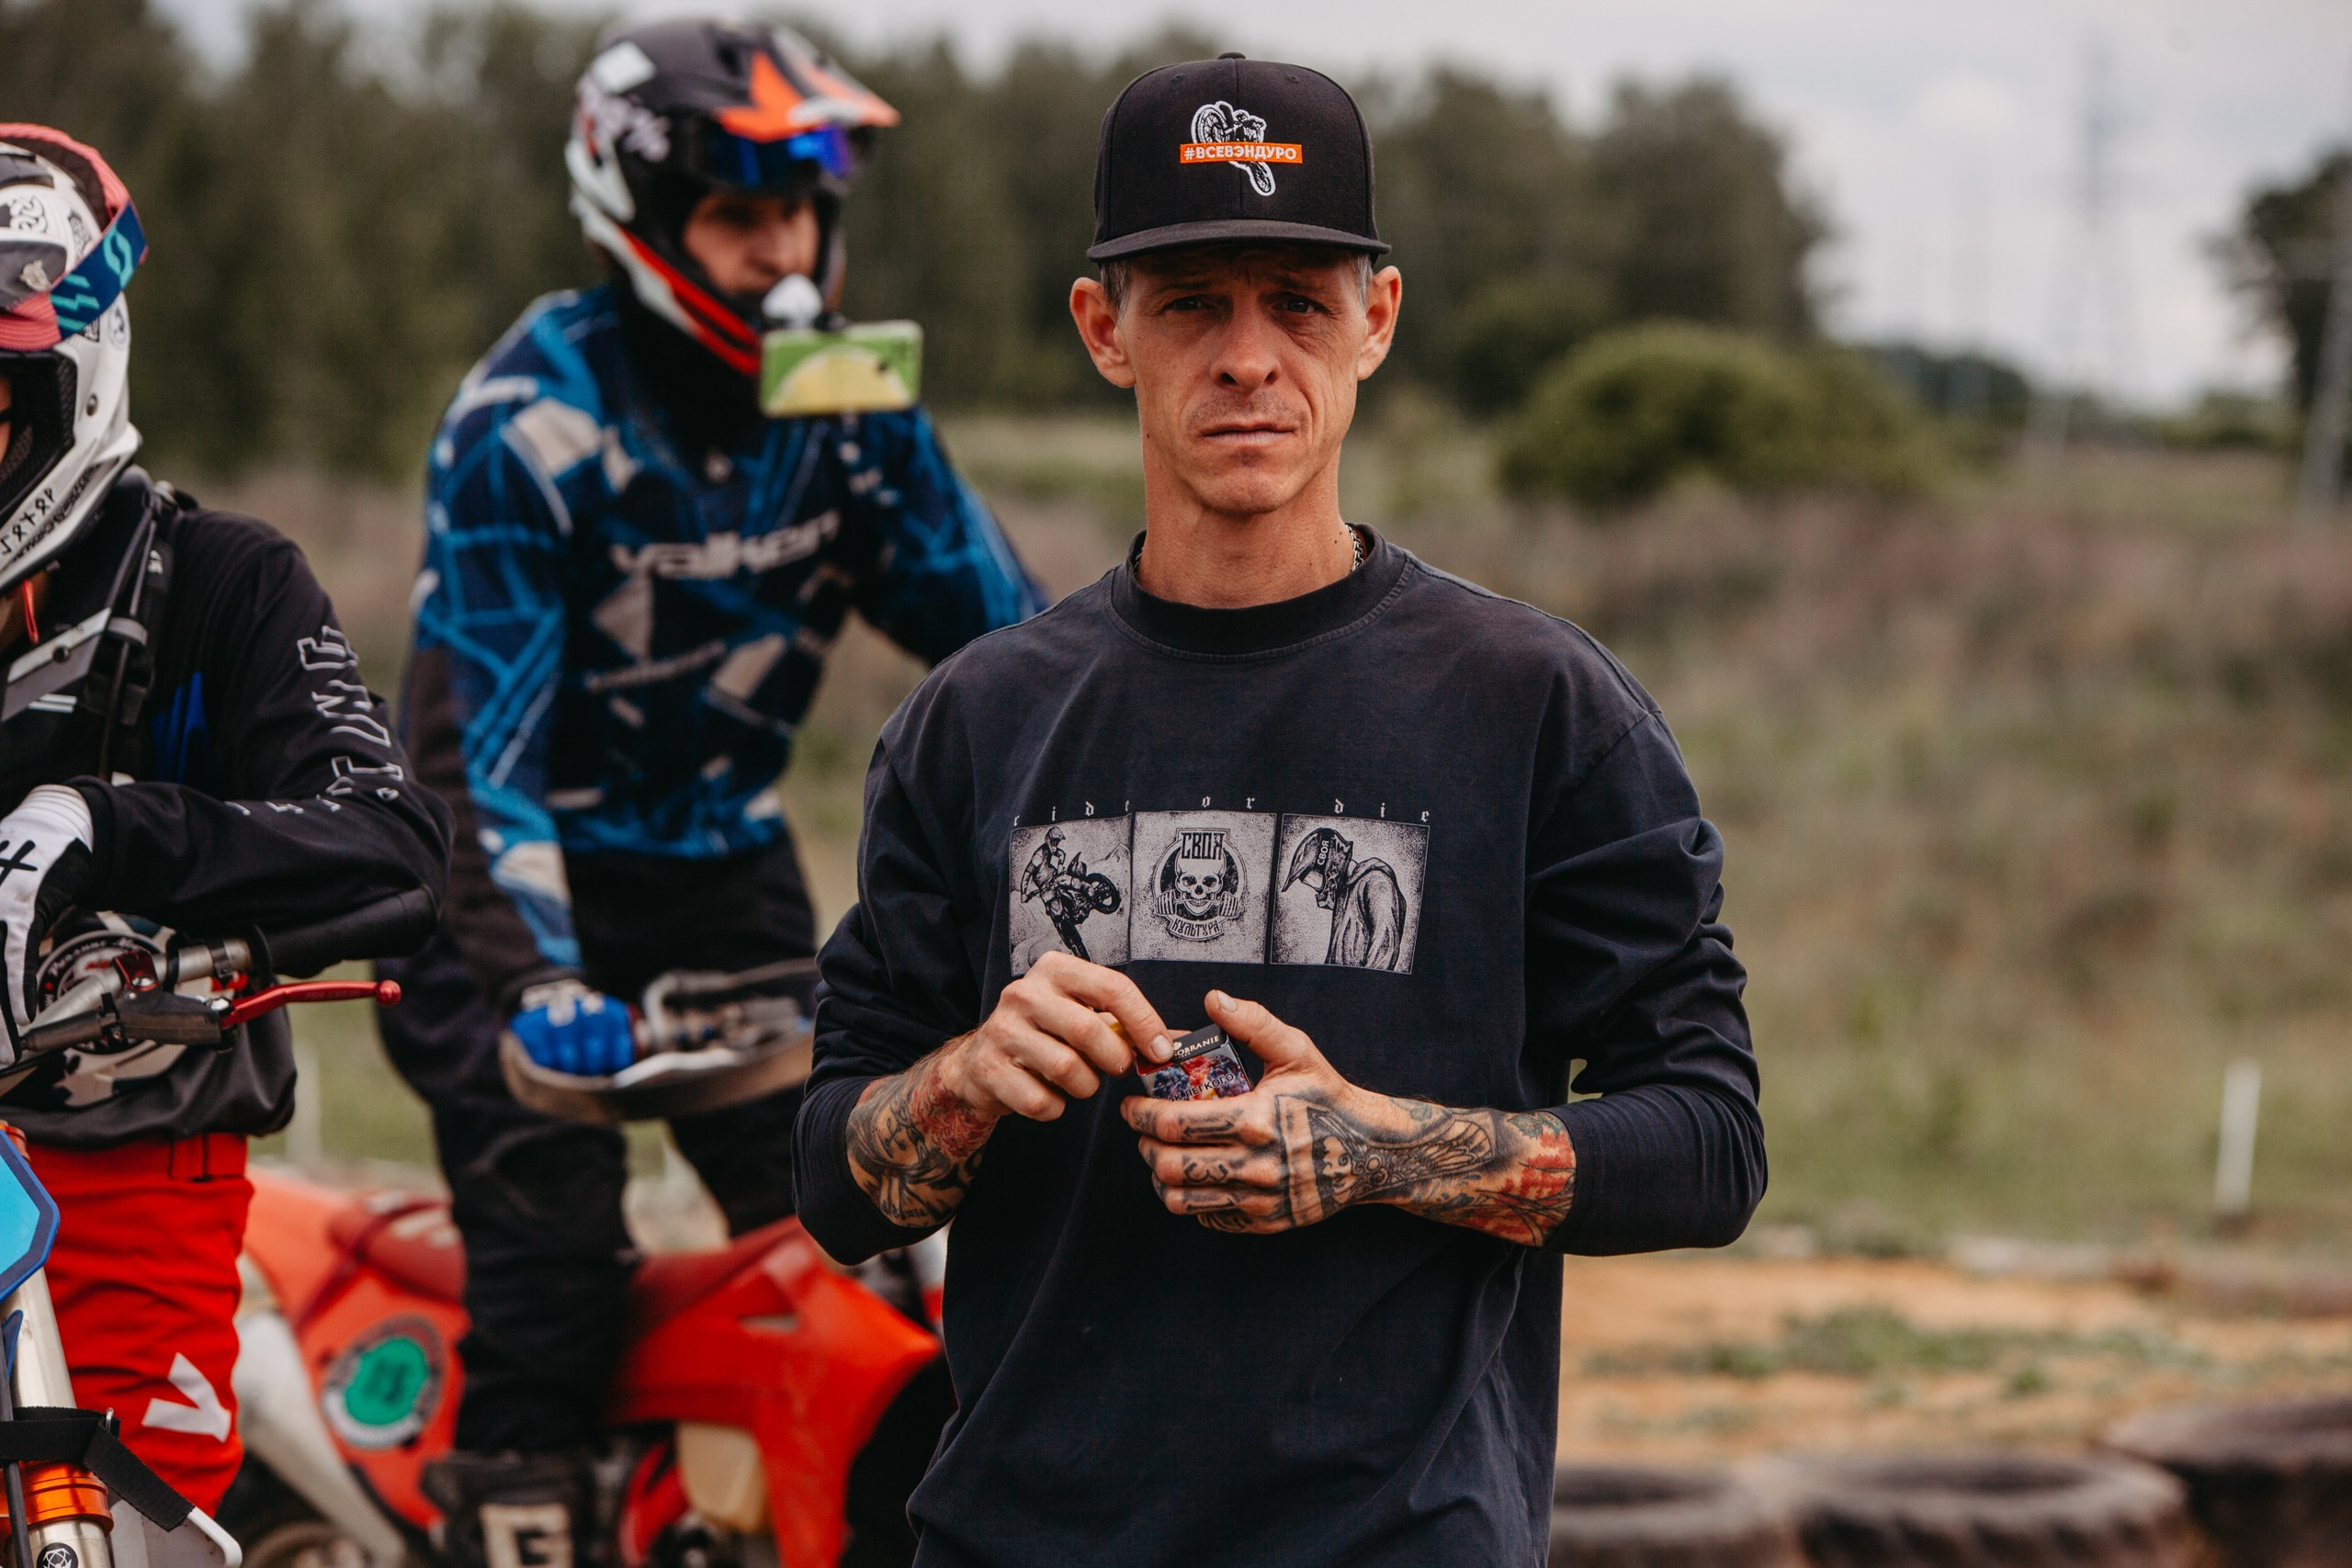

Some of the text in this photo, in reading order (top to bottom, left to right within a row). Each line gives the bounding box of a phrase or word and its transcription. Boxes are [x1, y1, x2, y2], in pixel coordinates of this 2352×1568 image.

[1184, 144, 1297, 161] #ВСЕВЭНДУРО
[1202, 795, 1256, 810] or
[1334, 798, 1430, 823] die
[1181, 832, 1226, 860] СВОЯ
[1317, 840, 1330, 865] СВОЯ
[1171, 919, 1220, 937] КУЛЬТУРА
[1185, 1073, 1234, 1098] ЛЕГКОГО
